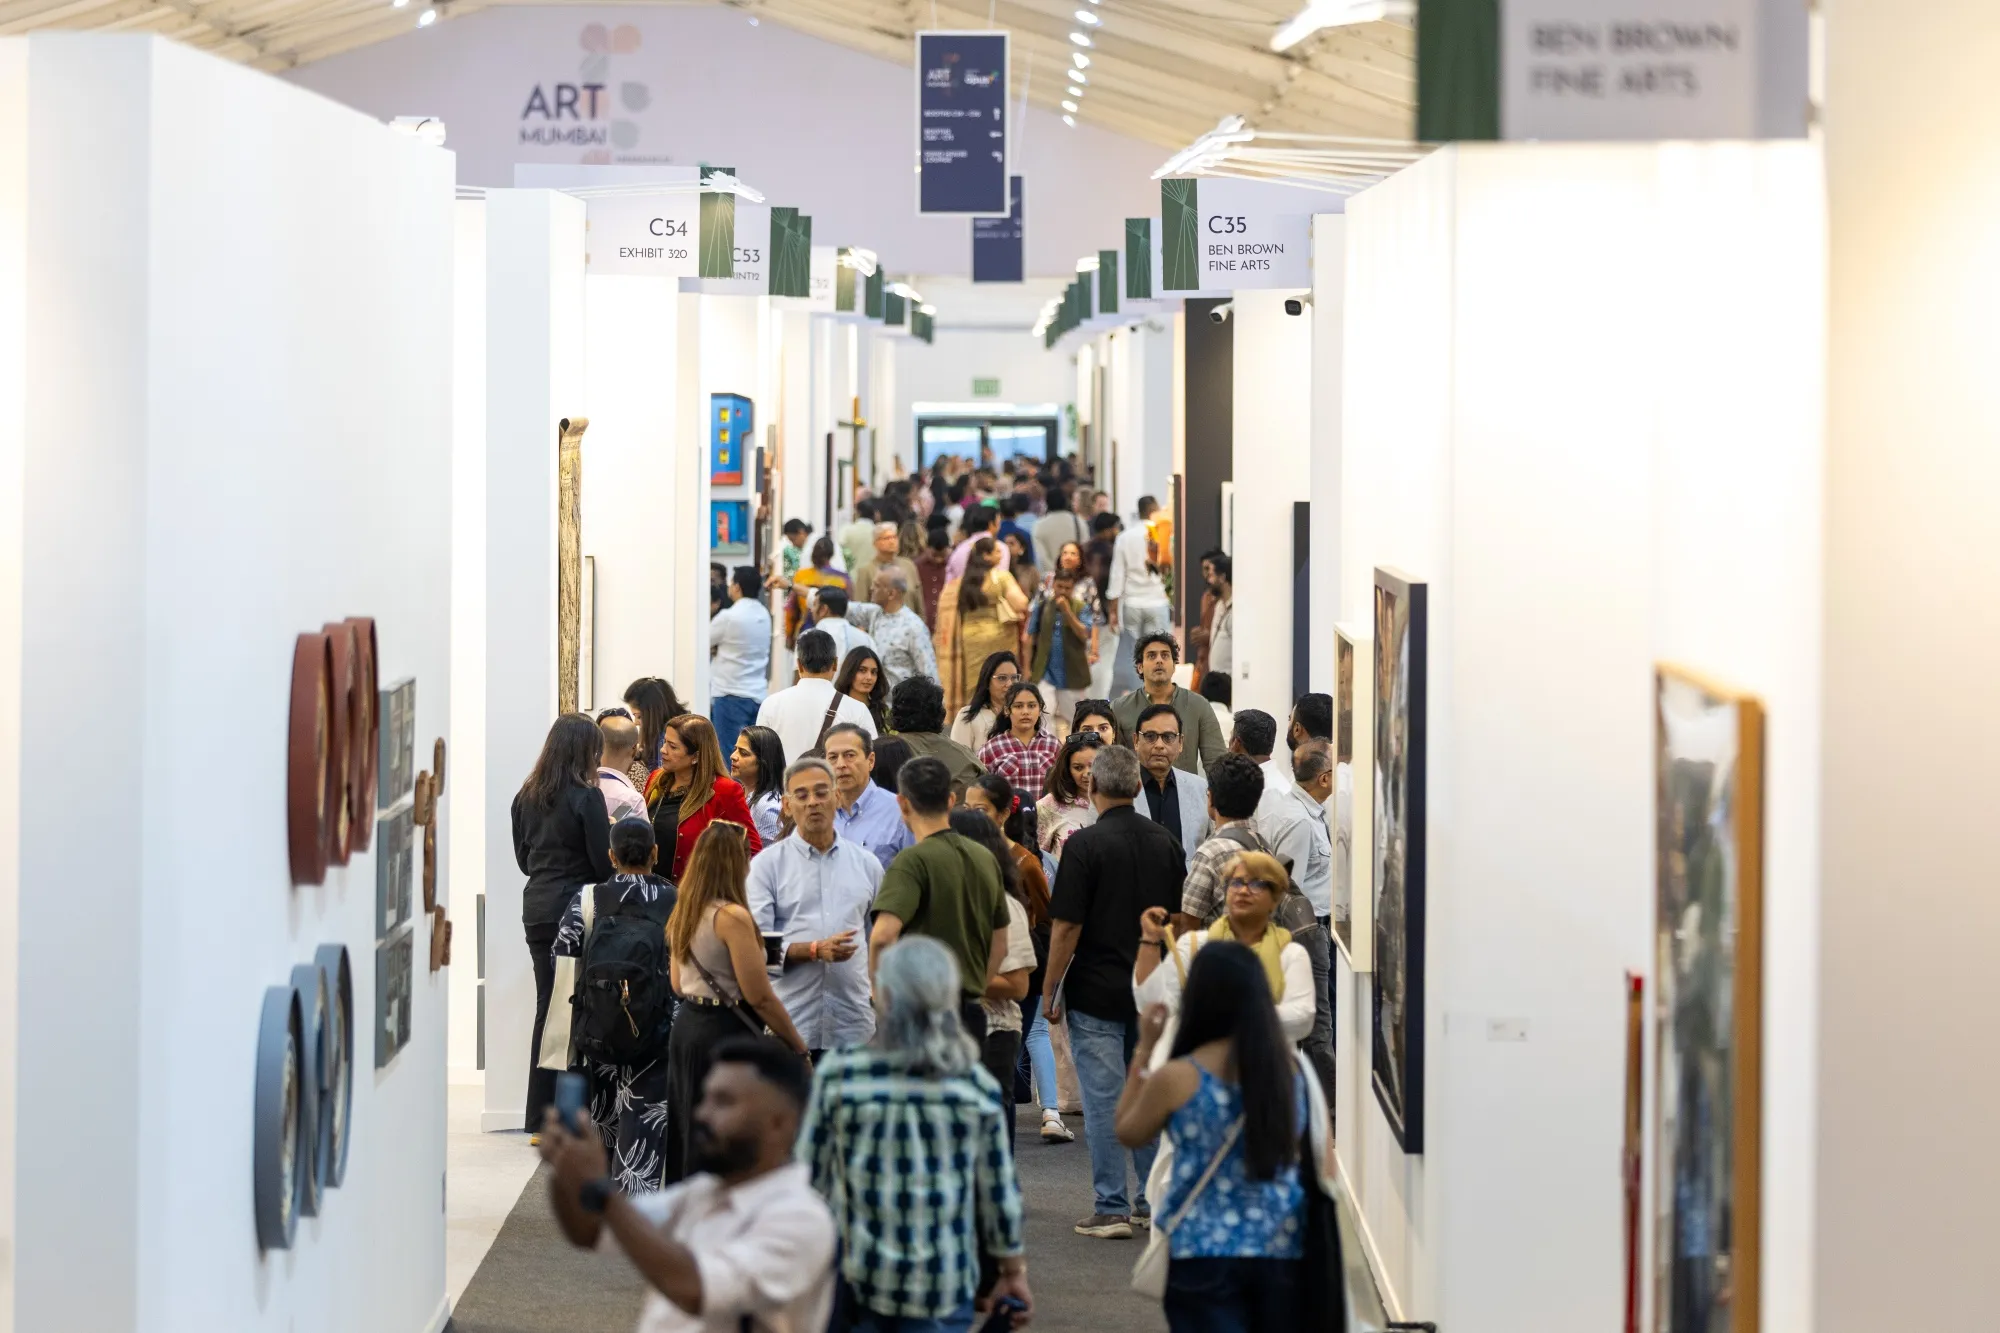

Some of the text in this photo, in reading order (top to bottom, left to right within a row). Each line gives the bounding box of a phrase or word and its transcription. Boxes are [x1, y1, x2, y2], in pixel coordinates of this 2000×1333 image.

[521, 83, 605, 120] ART
[517, 127, 607, 146] MUMBAI
[649, 217, 688, 236] C54
[1208, 215, 1247, 233] C35
[619, 247, 688, 259] EXHIBIT 320
[733, 247, 760, 263] C53
[1208, 243, 1284, 255] BEN BROWN
[1209, 259, 1270, 271] FINE ARTS
